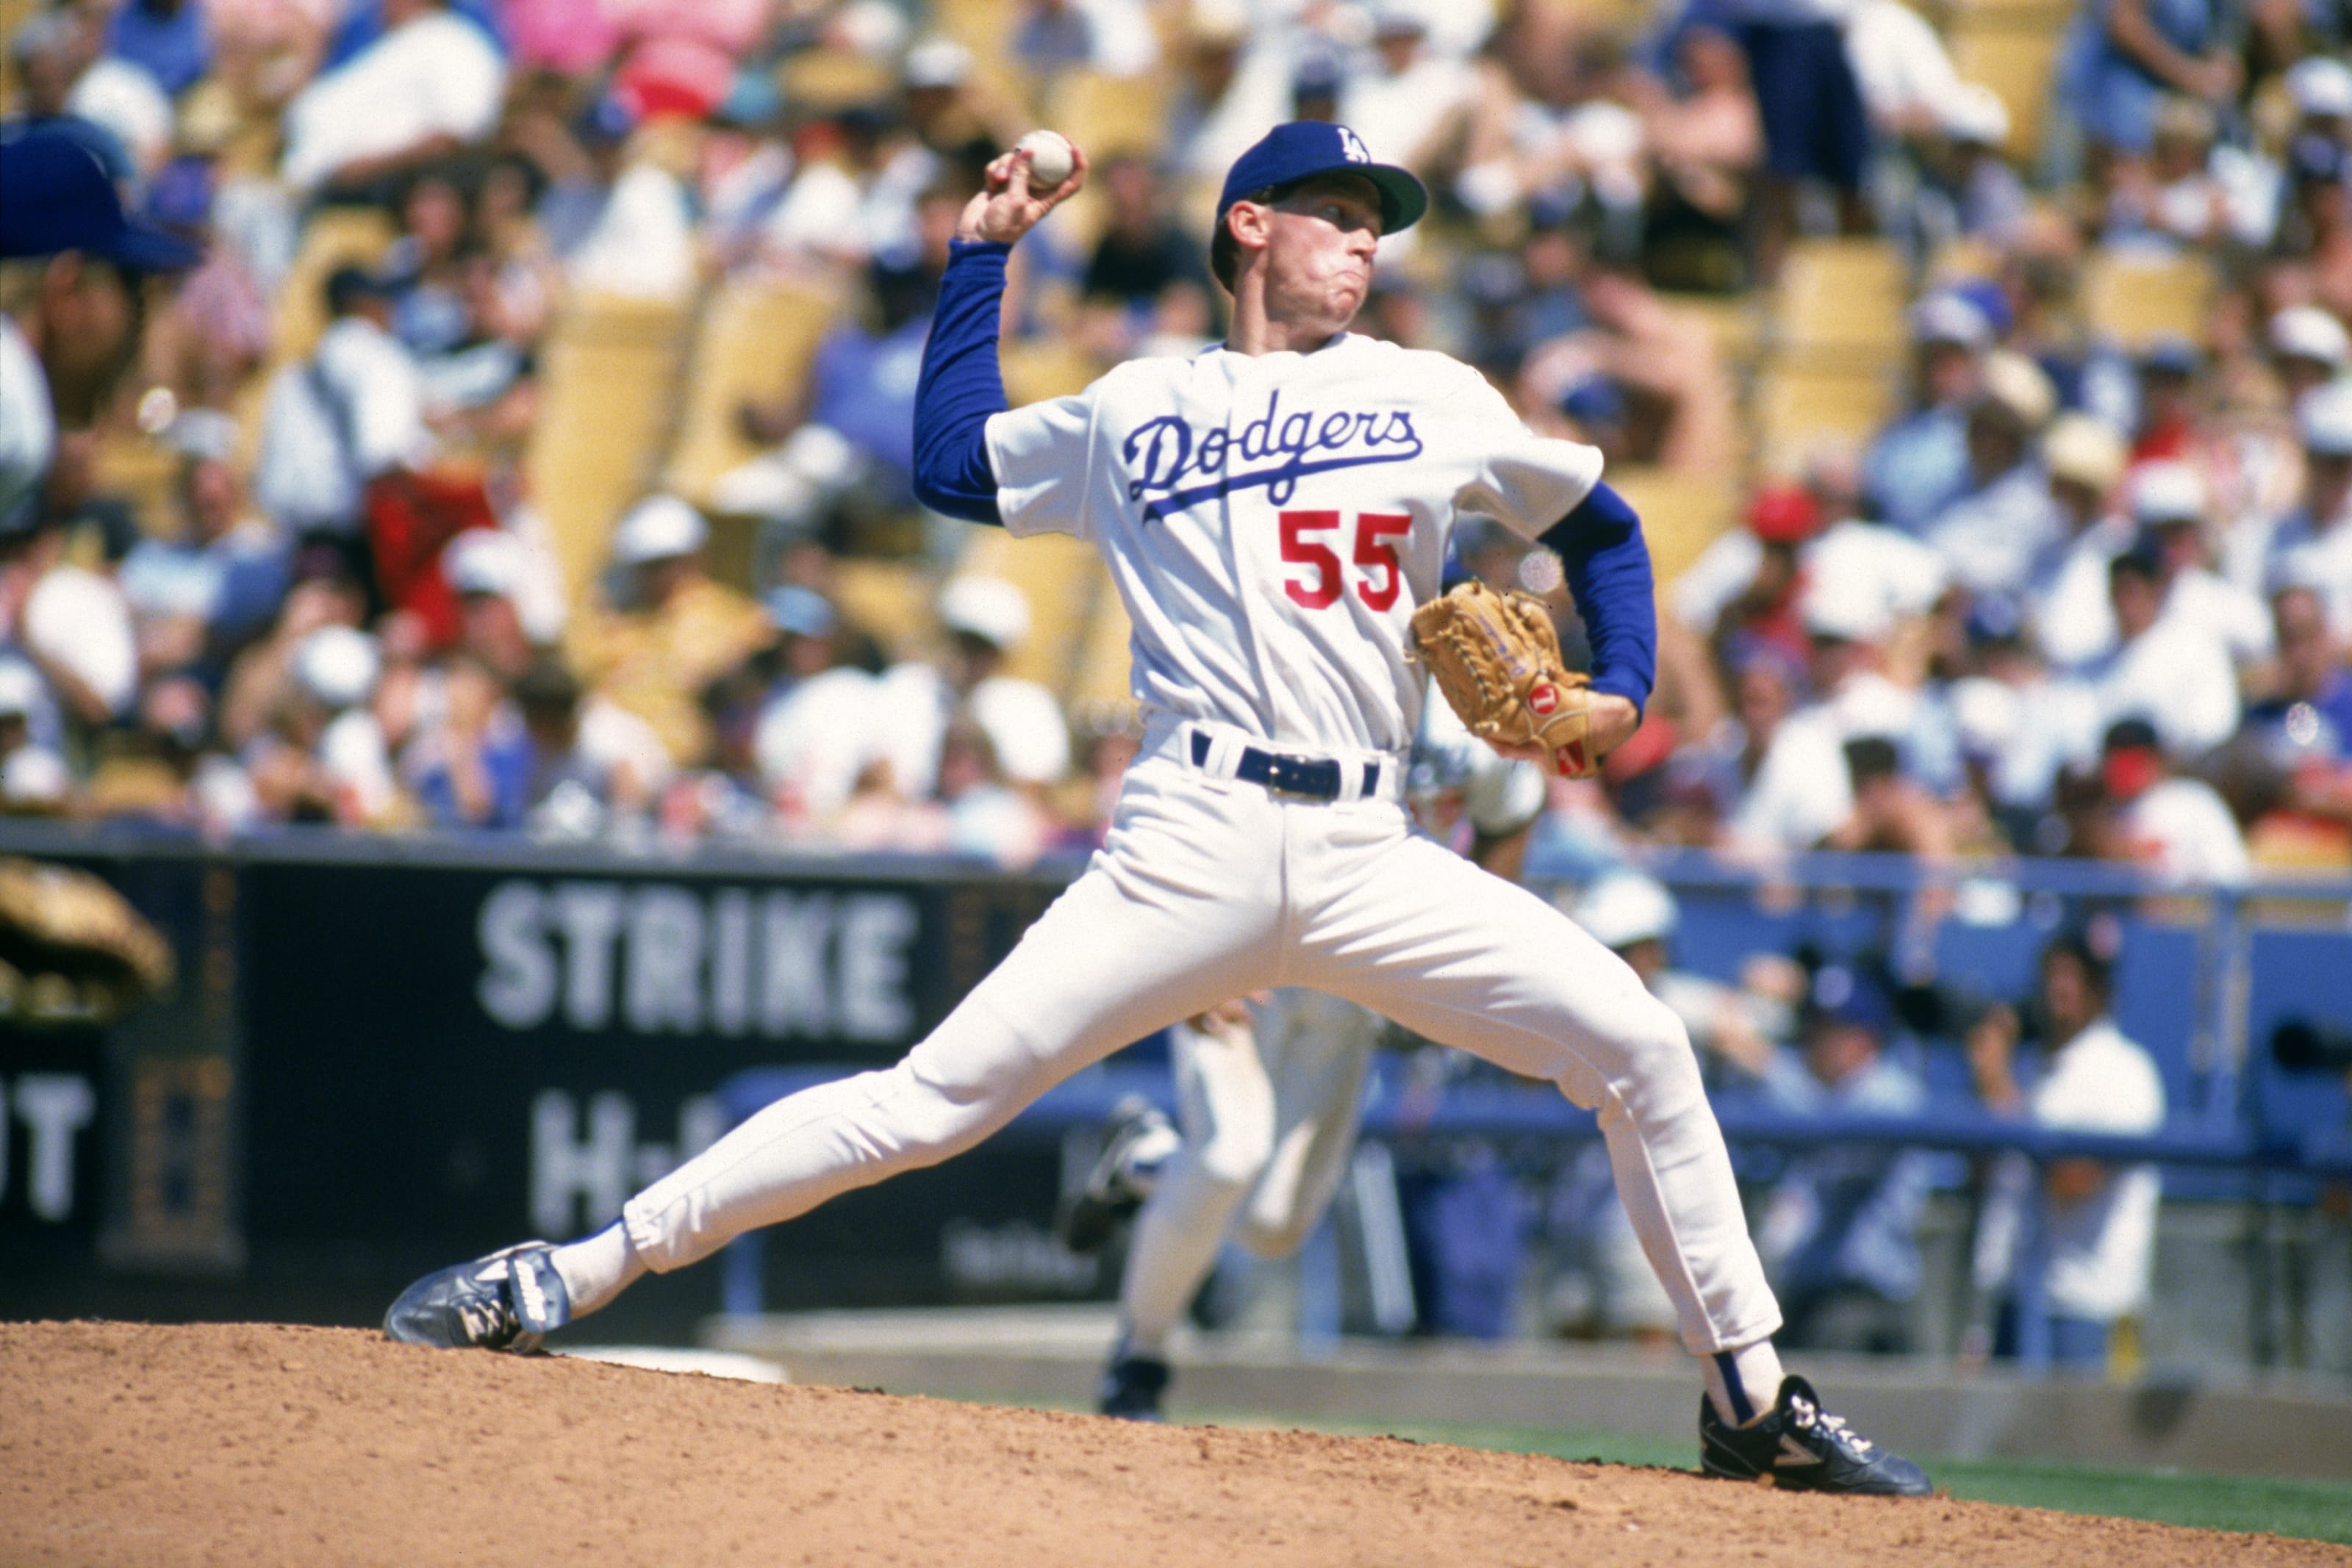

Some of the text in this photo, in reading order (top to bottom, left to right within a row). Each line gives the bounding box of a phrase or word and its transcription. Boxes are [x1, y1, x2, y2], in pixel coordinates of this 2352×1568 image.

[1122, 389, 1423, 508] Dodgers
[1278, 510, 1413, 612] 55
[478, 882, 916, 1039] STRIKE
